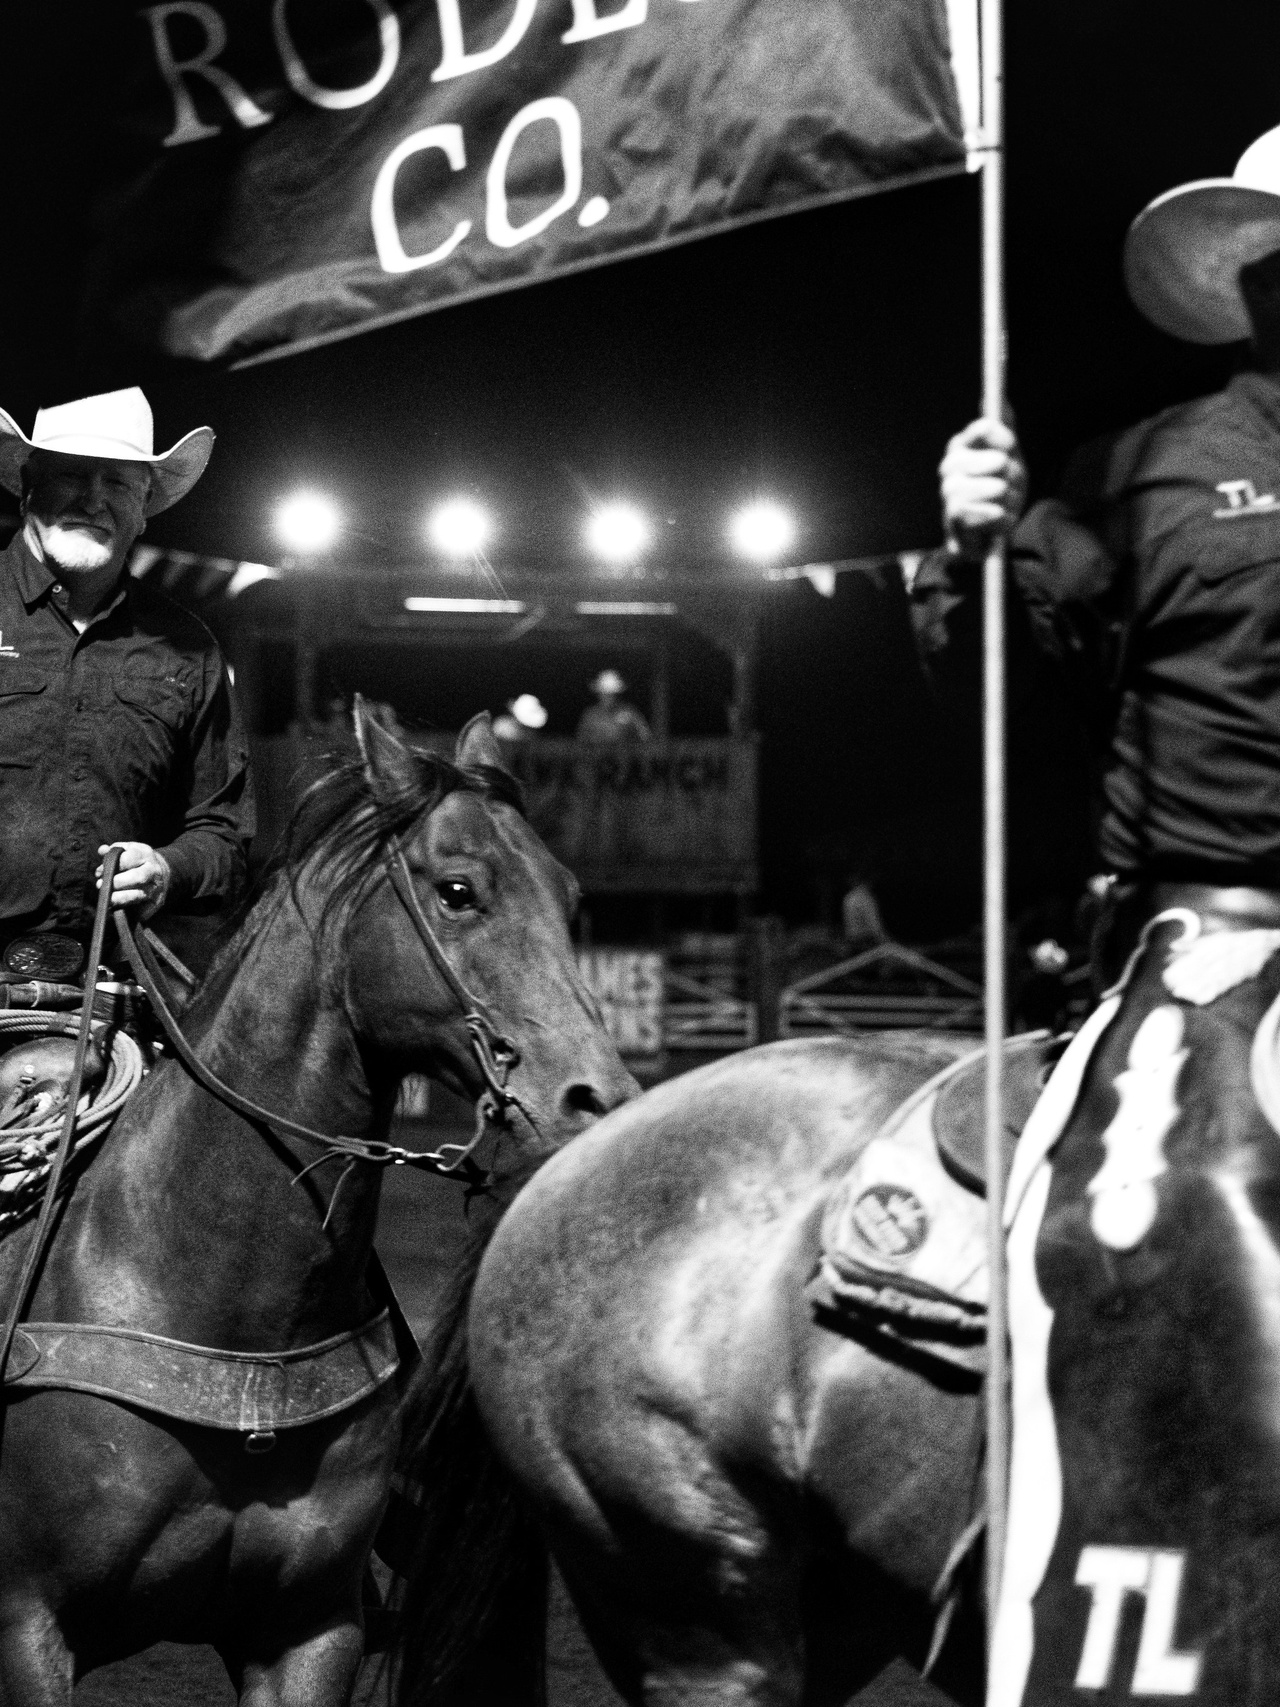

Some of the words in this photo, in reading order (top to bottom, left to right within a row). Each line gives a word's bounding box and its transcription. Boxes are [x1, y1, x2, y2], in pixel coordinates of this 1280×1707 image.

[147, 0, 708, 147] ROD
[371, 96, 610, 273] CO.
[1073, 1543, 1205, 1695] TL
